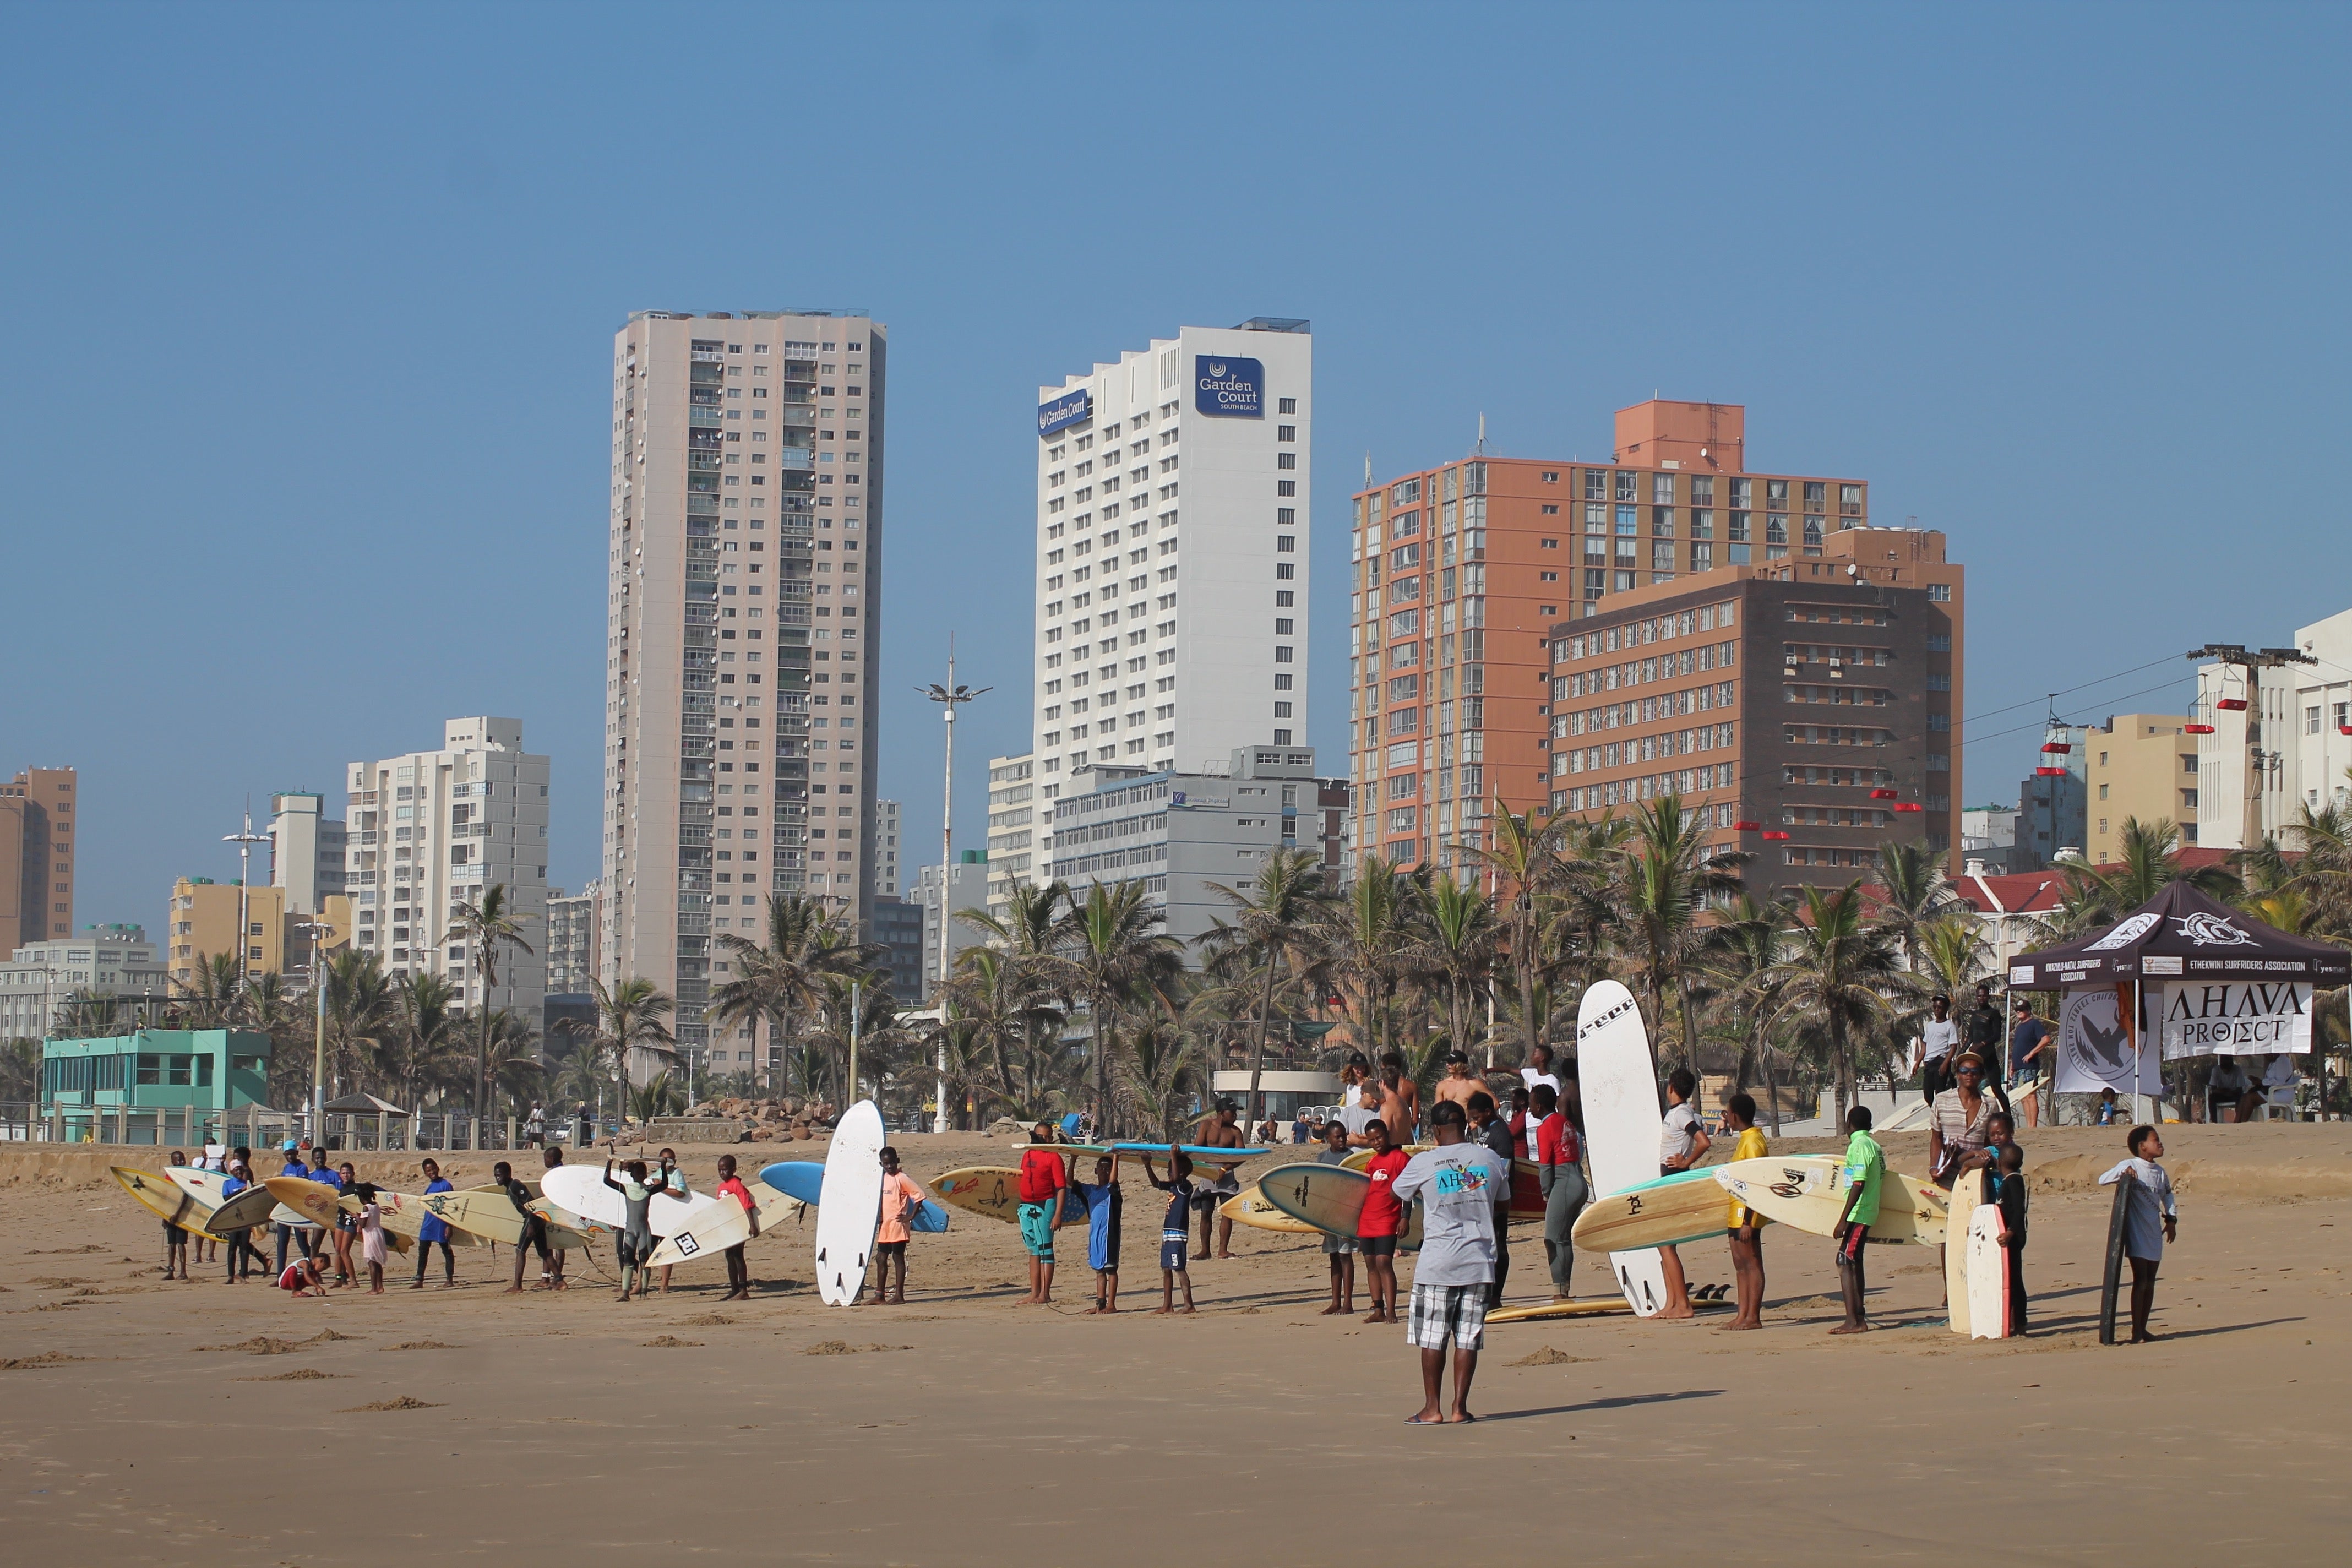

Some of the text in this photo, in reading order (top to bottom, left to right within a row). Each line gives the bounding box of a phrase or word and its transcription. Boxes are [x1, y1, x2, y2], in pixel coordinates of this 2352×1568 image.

[1200, 374, 1252, 391] Garden
[1218, 385, 1257, 403] Court
[1047, 396, 1085, 424] Garden Court
[2045, 959, 2101, 972] KWAZULU-NATAL SURFRIDERS
[2190, 960, 2224, 970] ETHEKWINI
[2224, 960, 2263, 970] SURFRIDERS
[2264, 961, 2306, 971] ASSOCIATION
[2320, 965, 2346, 973] yesman
[2060, 971, 2086, 982] ASSOCIATION
[2168, 982, 2305, 1022] AHAVA
[2183, 1020, 2286, 1045] PROJECT
[1438, 1172, 1486, 1189] AHVA
[1828, 1170, 1838, 1190] Hurley
[1301, 1175, 1309, 1208] SPIDER
